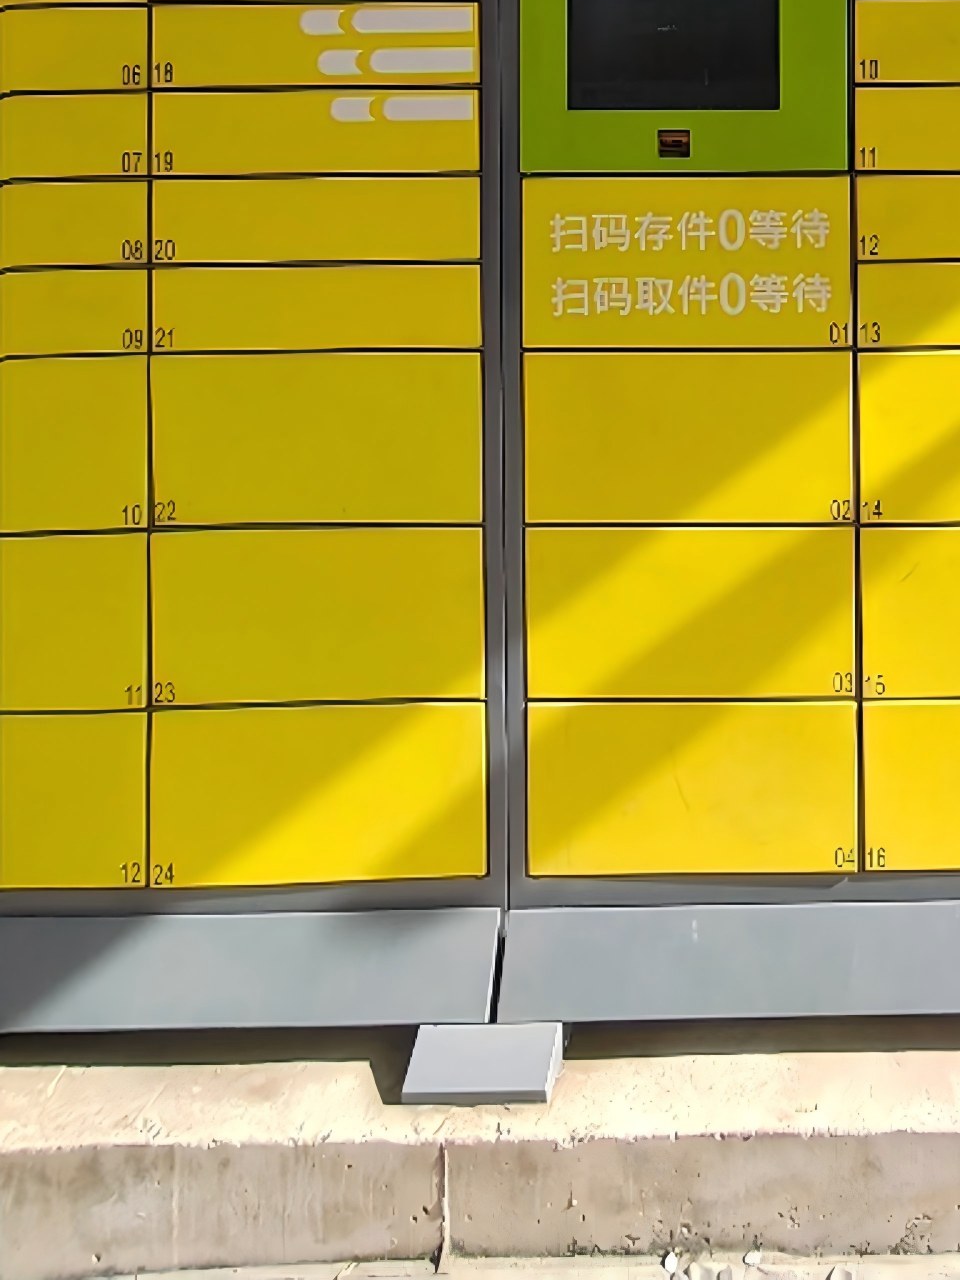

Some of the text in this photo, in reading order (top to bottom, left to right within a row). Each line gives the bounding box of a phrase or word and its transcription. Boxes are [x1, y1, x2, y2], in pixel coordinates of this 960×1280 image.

[122, 65, 140, 85] 06
[154, 62, 173, 83] 18
[859, 58, 879, 79] 10
[122, 152, 142, 172] 07
[155, 151, 173, 172] 19
[859, 147, 876, 167] 11
[550, 208, 830, 252] 扫码存件0等待
[155, 240, 176, 260] 20
[859, 234, 880, 255] 12
[551, 272, 832, 316] 扫码取件0等待
[122, 328, 143, 348] 09
[155, 327, 175, 347] 21
[829, 322, 848, 344] 01
[859, 322, 881, 343] 13
[122, 504, 141, 525] 10
[155, 500, 176, 521] 22
[830, 499, 850, 520] 02
[862, 499, 883, 520] 14
[155, 682, 176, 703] 23
[833, 672, 852, 692] 03
[865, 674, 885, 695] 15
[125, 685, 143, 705] 11
[834, 847, 854, 867] 04
[868, 847, 886, 867] 16
[120, 862, 140, 882] 12
[153, 862, 174, 885] 24
